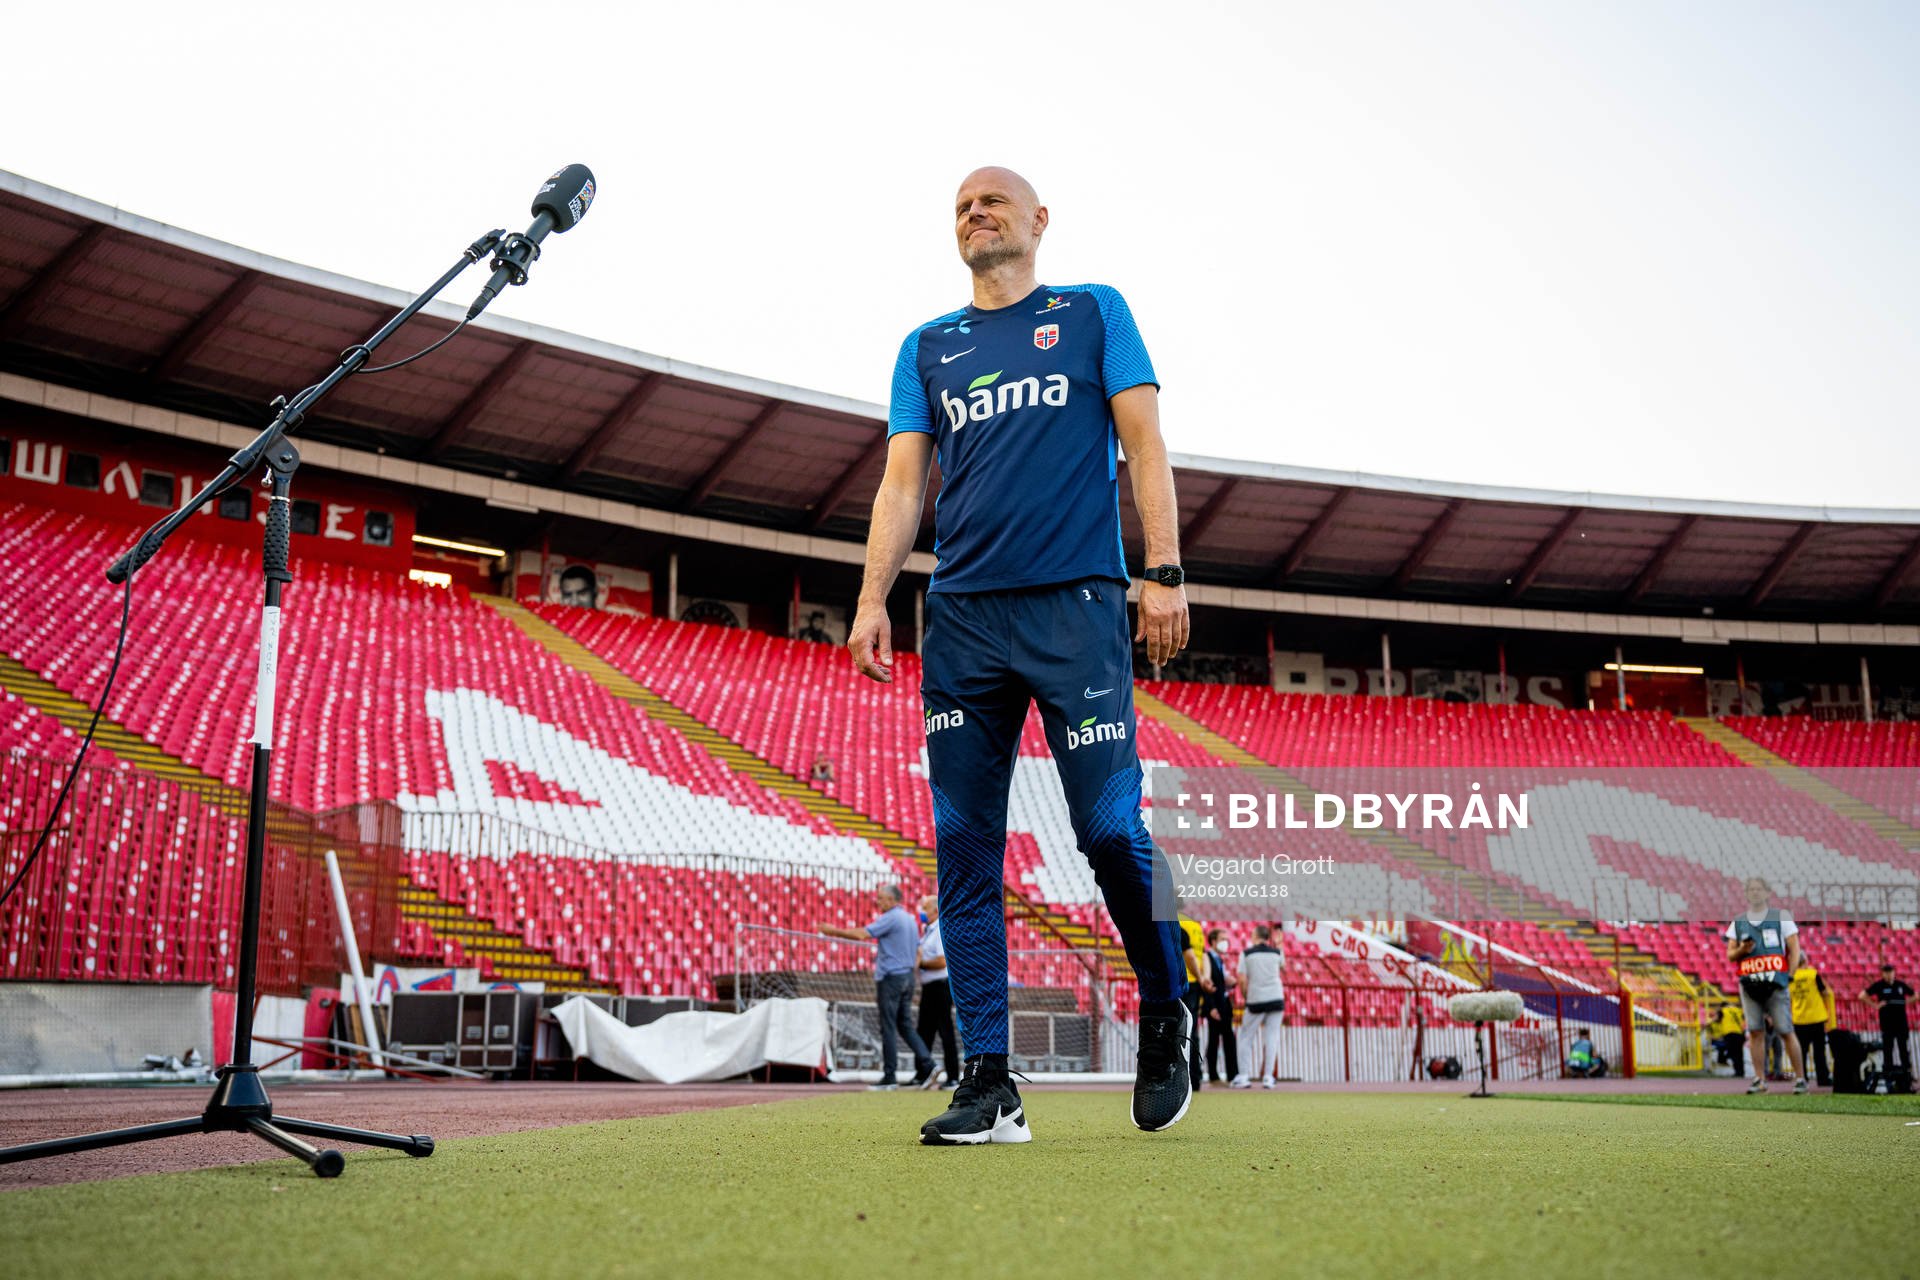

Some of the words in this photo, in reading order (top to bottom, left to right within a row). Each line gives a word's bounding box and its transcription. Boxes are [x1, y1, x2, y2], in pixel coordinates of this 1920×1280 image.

[941, 373, 1070, 433] bama
[925, 708, 964, 736] ama
[1066, 719, 1127, 750] bama
